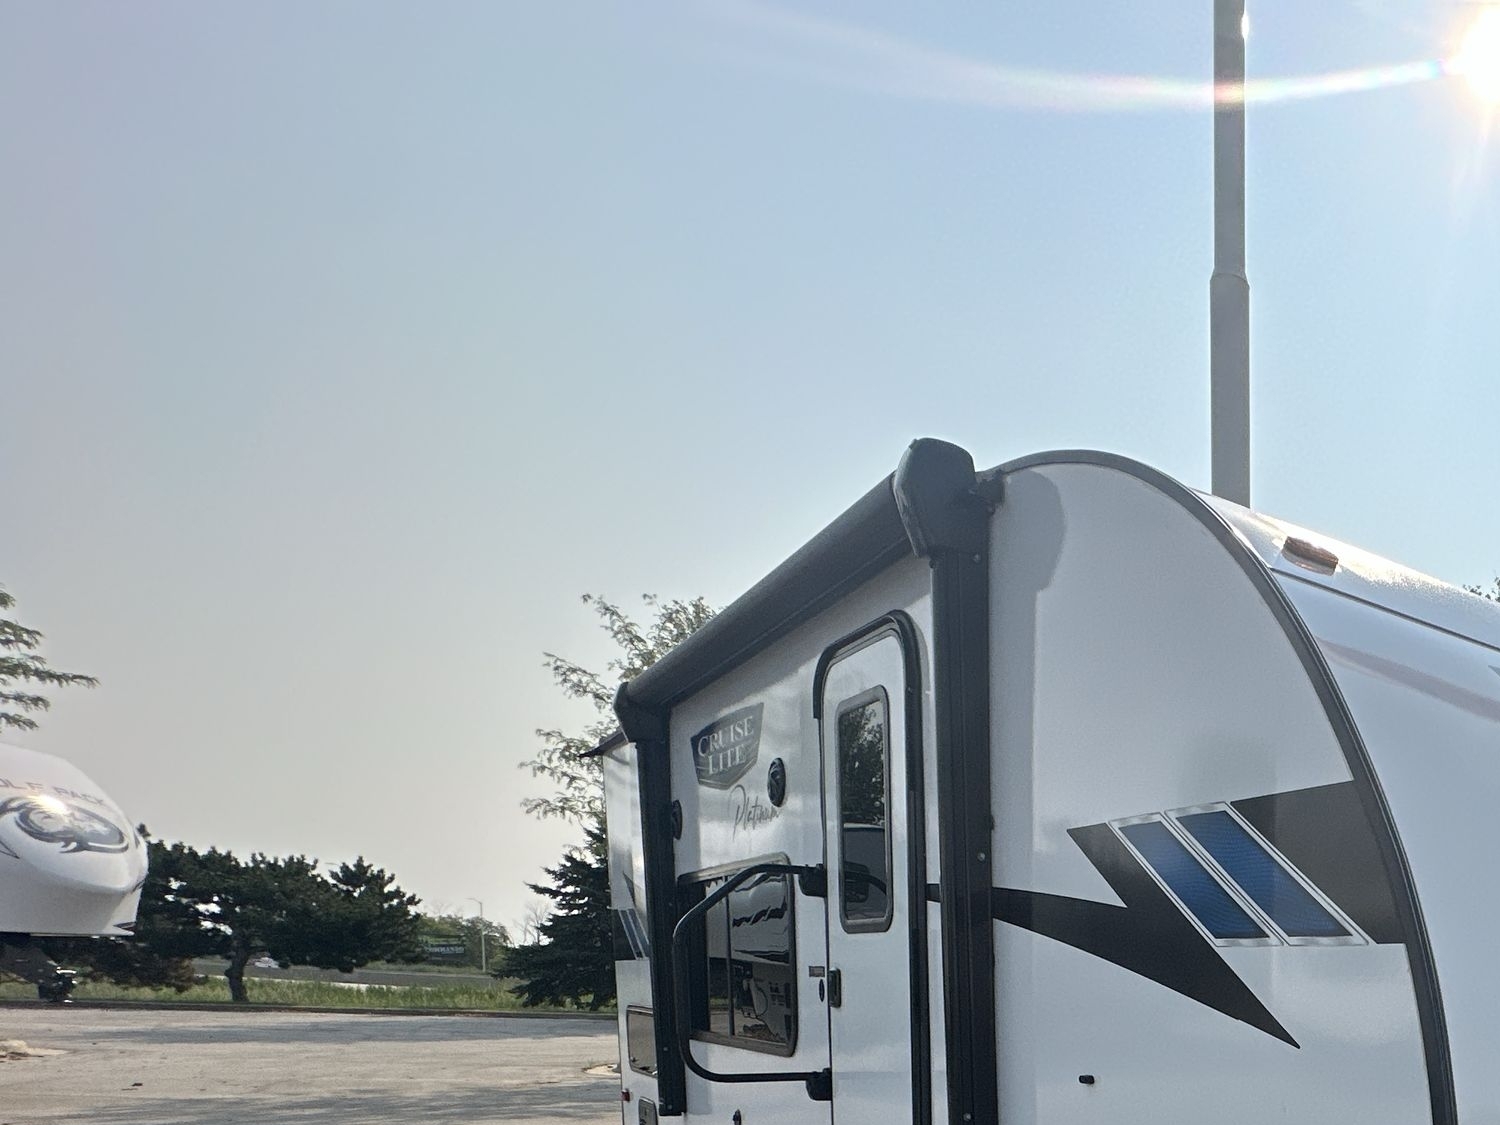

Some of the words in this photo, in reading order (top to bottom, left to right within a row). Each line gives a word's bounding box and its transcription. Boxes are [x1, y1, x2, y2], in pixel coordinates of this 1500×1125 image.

[697, 715, 755, 758] CRUISE
[707, 743, 748, 775] LITE
[727, 784, 780, 842] Platinum
